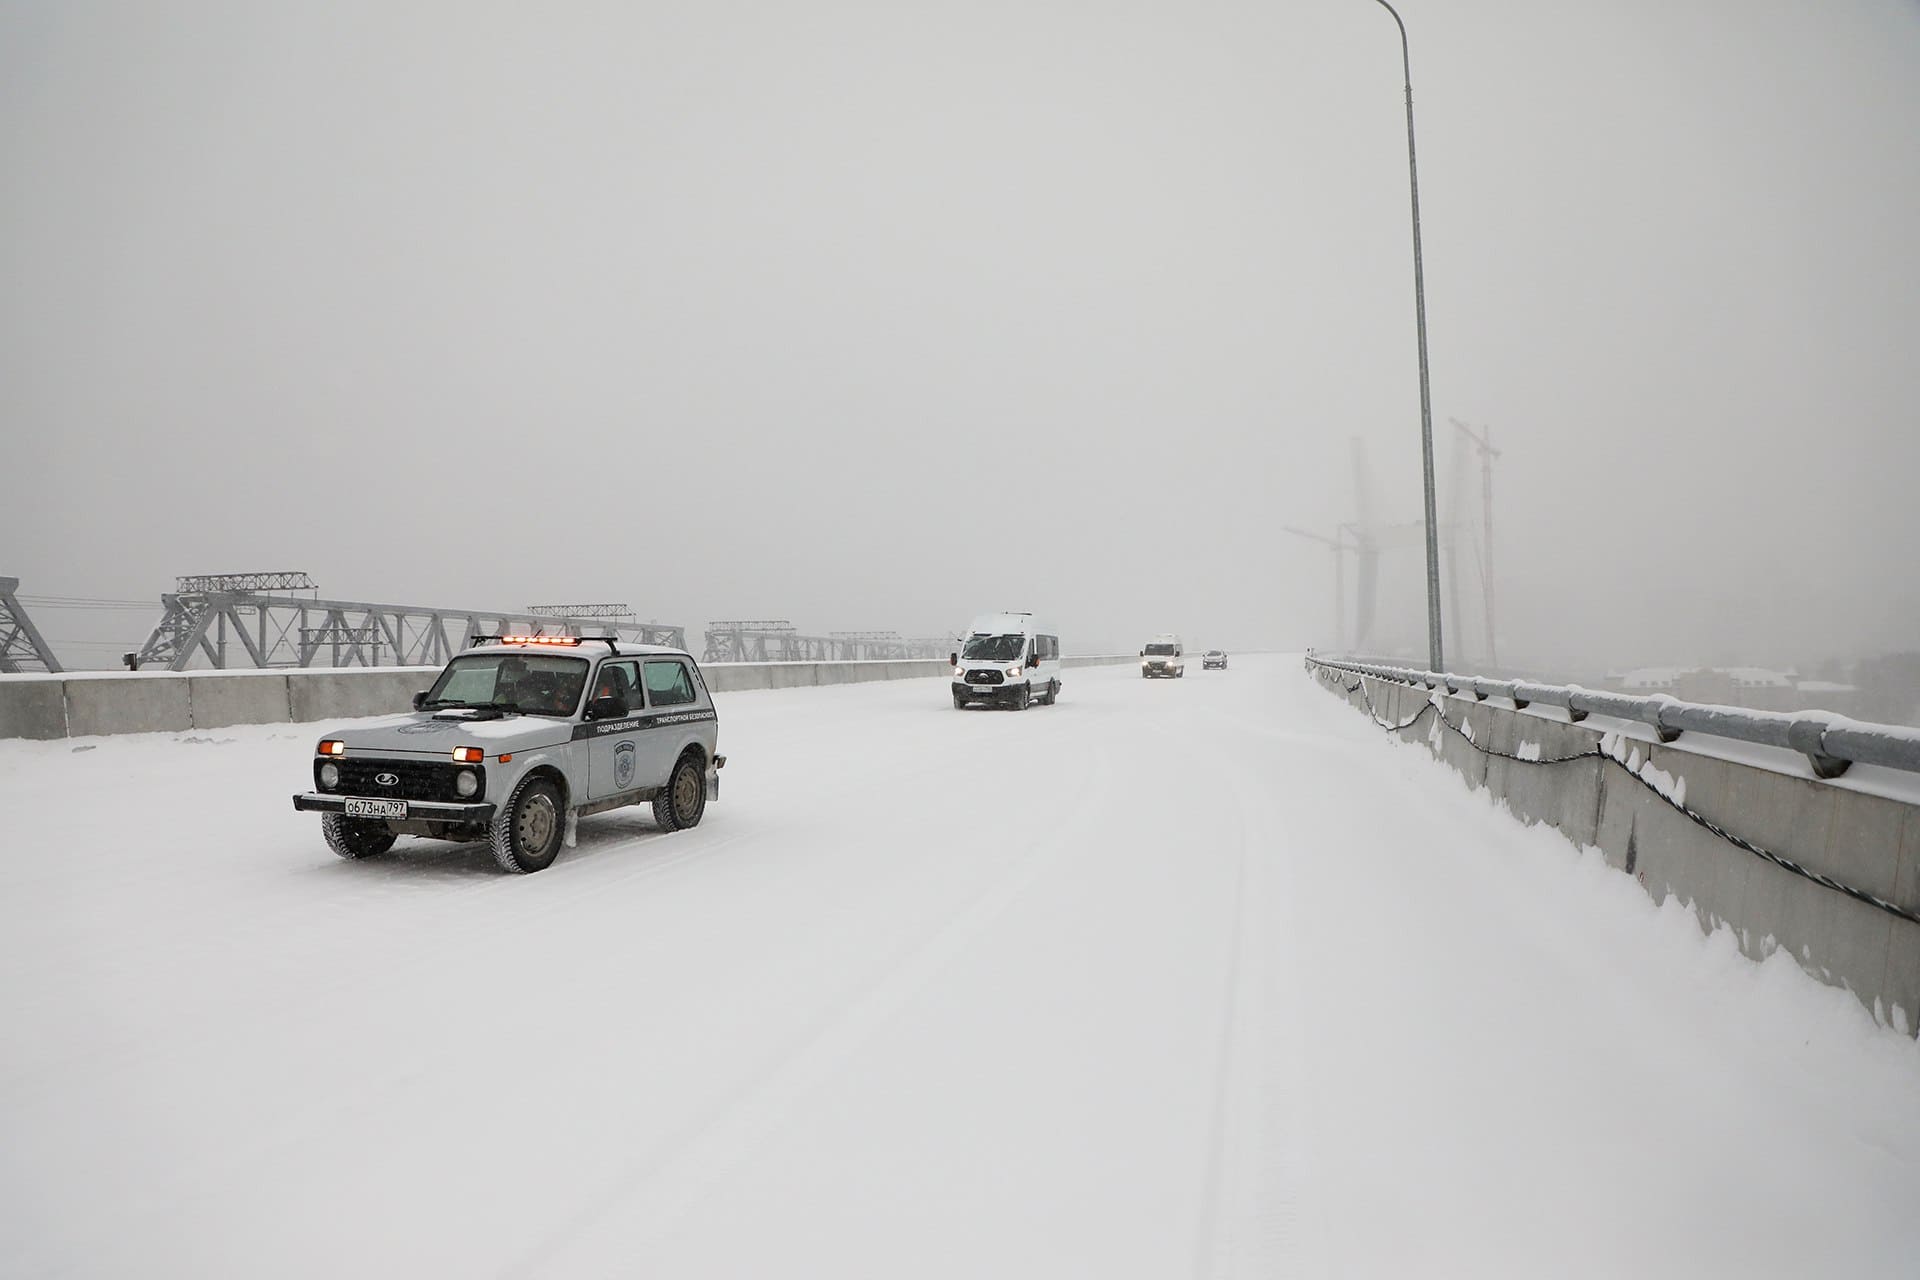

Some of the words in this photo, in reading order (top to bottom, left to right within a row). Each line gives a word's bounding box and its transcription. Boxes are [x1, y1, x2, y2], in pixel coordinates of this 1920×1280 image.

[597, 721, 639, 733] ПОДРАЗДЕЛЕНИЕ
[656, 715, 688, 724] ТРАНСПОРТНОЙ
[388, 802, 404, 812] 797
